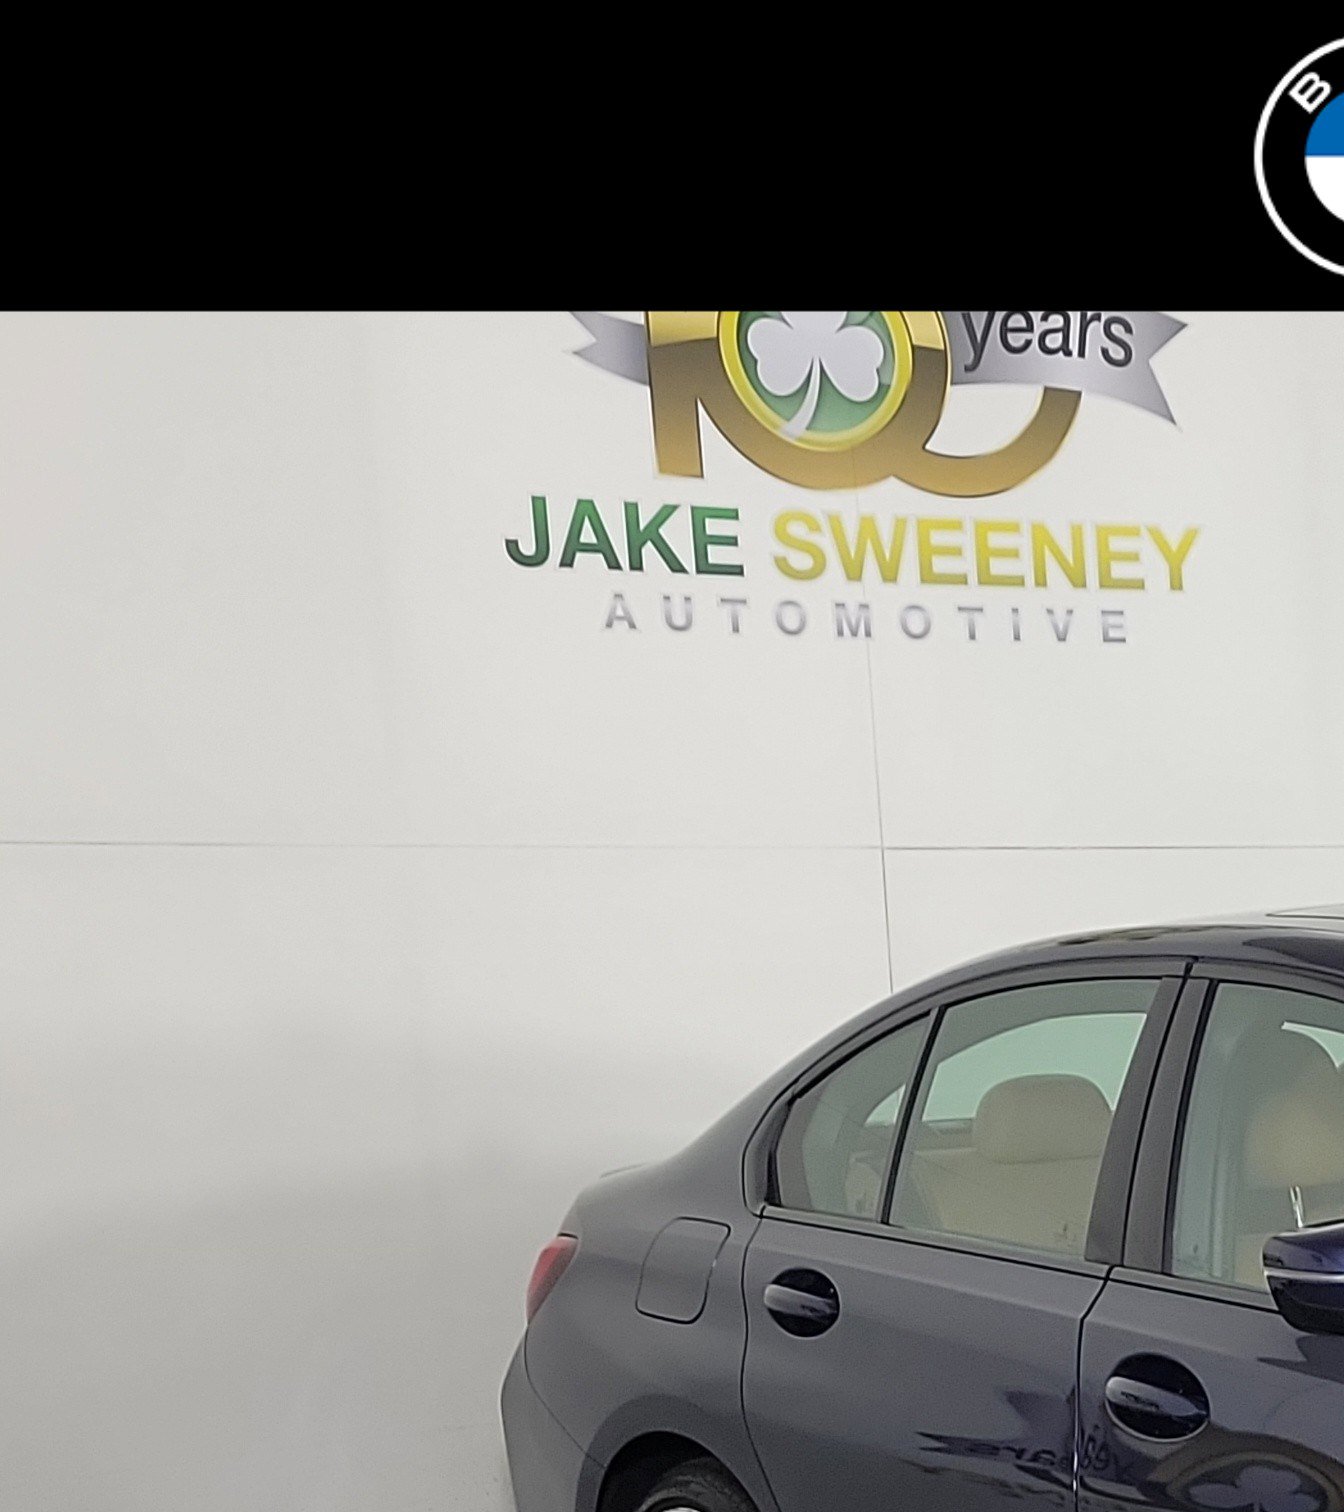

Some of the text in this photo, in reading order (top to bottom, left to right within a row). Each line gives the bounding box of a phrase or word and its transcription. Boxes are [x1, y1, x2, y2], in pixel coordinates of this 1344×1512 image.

[960, 312, 1135, 374] years
[503, 495, 1200, 592] JAKE SWEENEY
[603, 592, 1128, 644] AUTOMOTIVE
